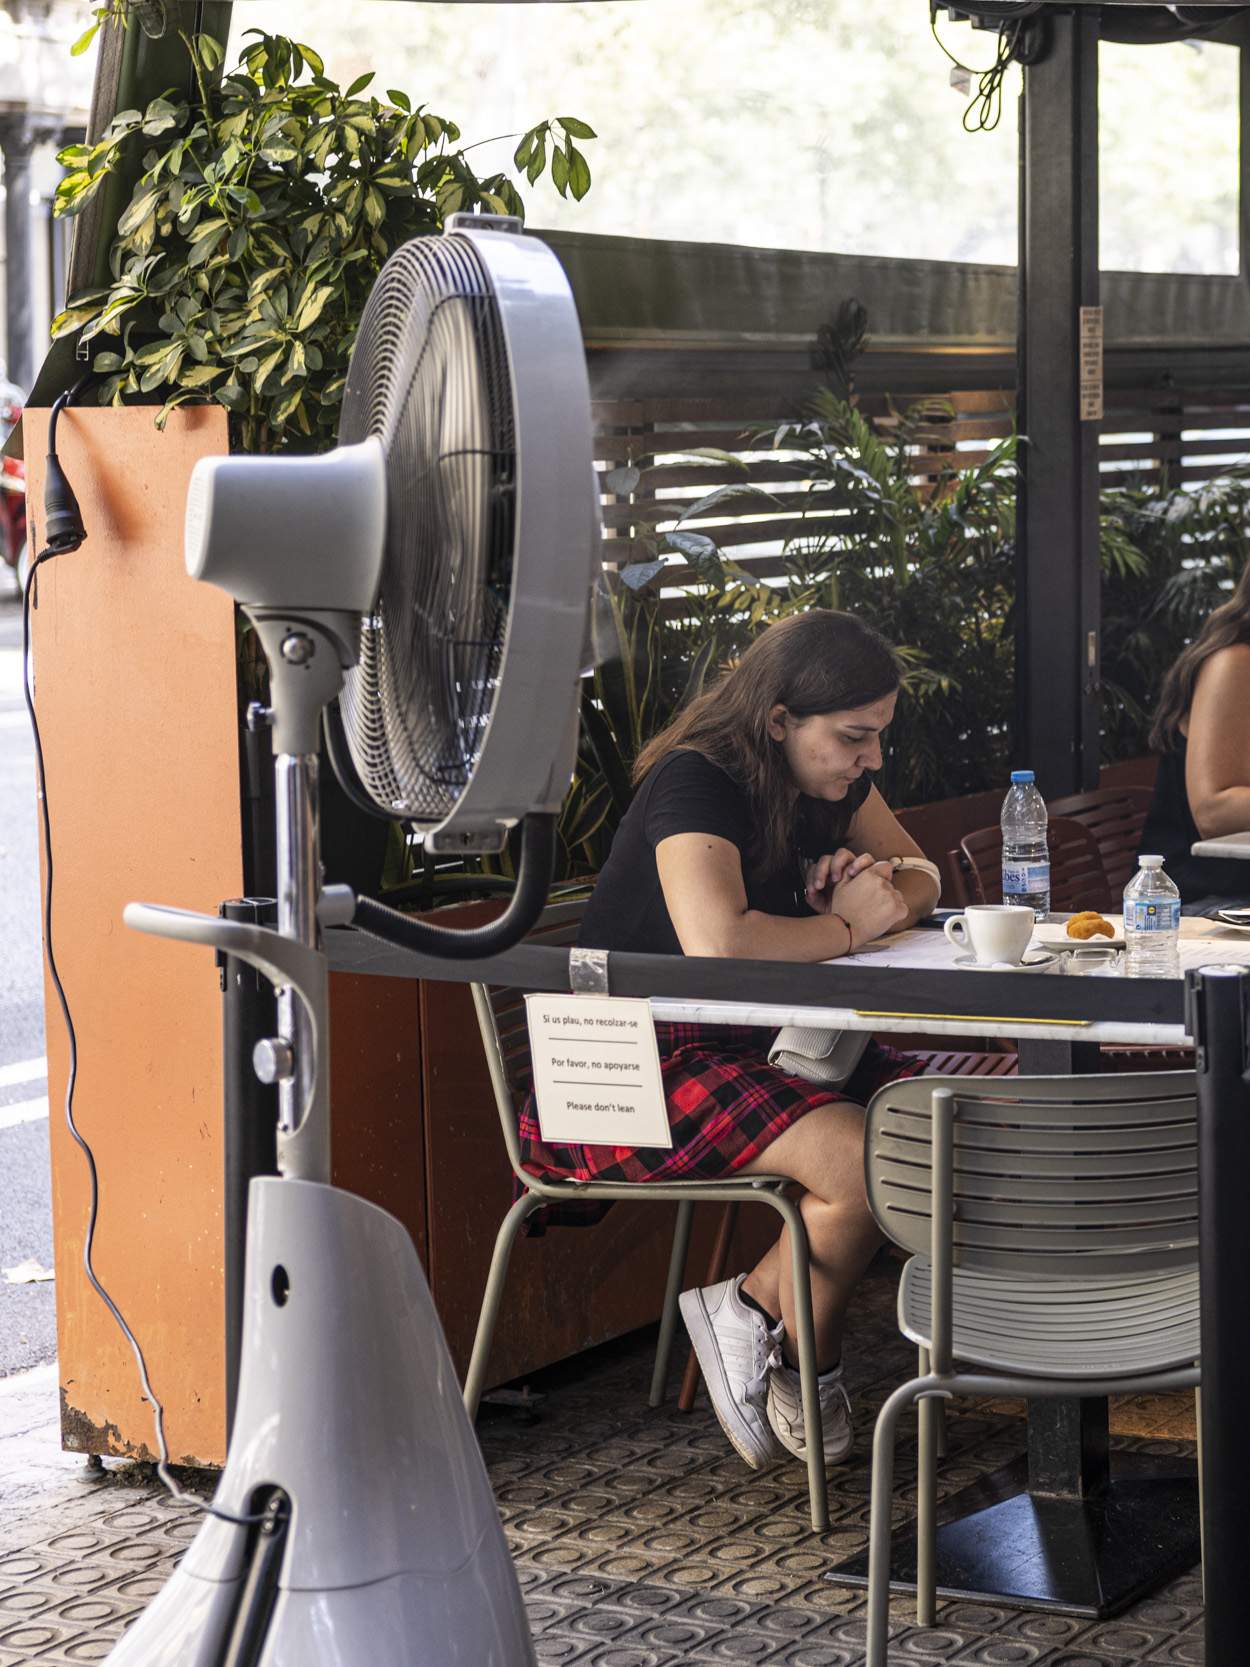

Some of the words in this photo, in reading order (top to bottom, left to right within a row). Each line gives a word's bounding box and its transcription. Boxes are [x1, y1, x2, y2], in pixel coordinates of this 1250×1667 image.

[543, 1014, 550, 1023] Si
[552, 1016, 561, 1024] us
[562, 1015, 582, 1026] plau,
[583, 1017, 594, 1025] no
[595, 1018, 638, 1028] recolzar-se
[551, 1057, 565, 1067] Por
[566, 1058, 590, 1069] favor,
[591, 1061, 602, 1069] no
[604, 1061, 640, 1072] apoyarse
[566, 1101, 592, 1111] Please
[594, 1102, 616, 1112] don't
[617, 1103, 635, 1113] lean
